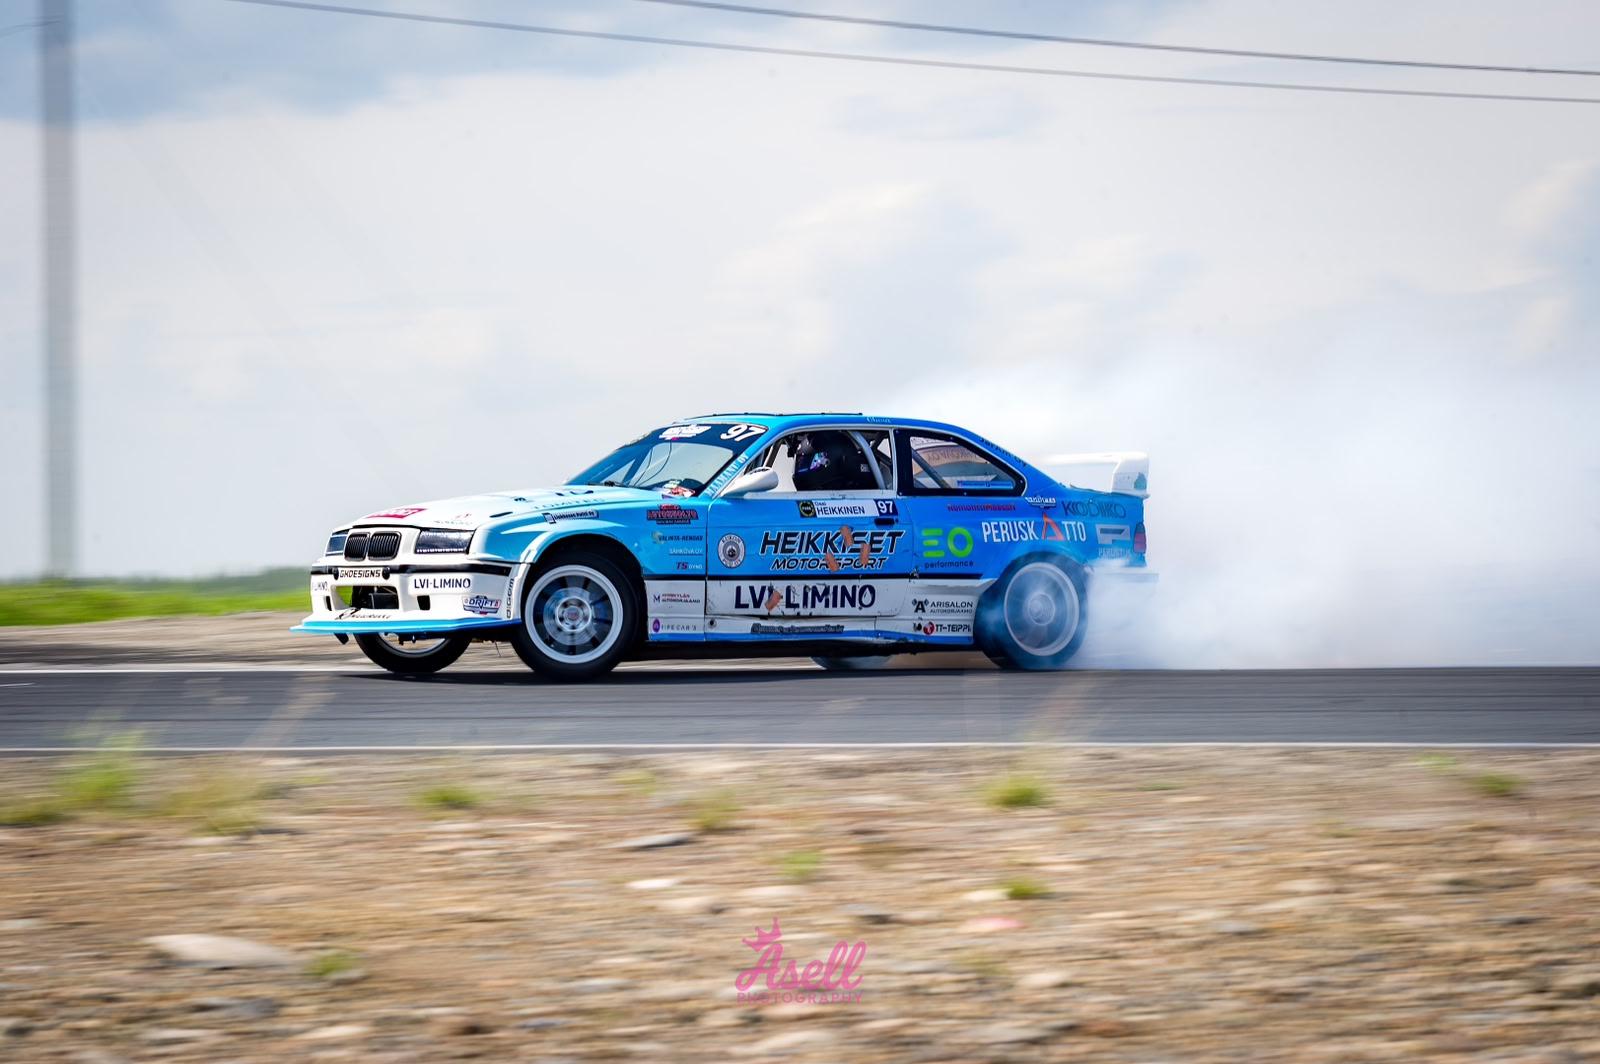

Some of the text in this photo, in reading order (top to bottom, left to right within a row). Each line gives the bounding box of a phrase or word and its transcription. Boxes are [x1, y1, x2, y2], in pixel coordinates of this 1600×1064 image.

[720, 424, 768, 441] 97
[817, 506, 865, 516] HEIKKINEN
[877, 501, 893, 514] 97
[924, 560, 974, 569] performance
[414, 578, 471, 589] LVI-LIMINO
[735, 585, 876, 609] LVLIMINO
[469, 598, 494, 609] DRIFT
